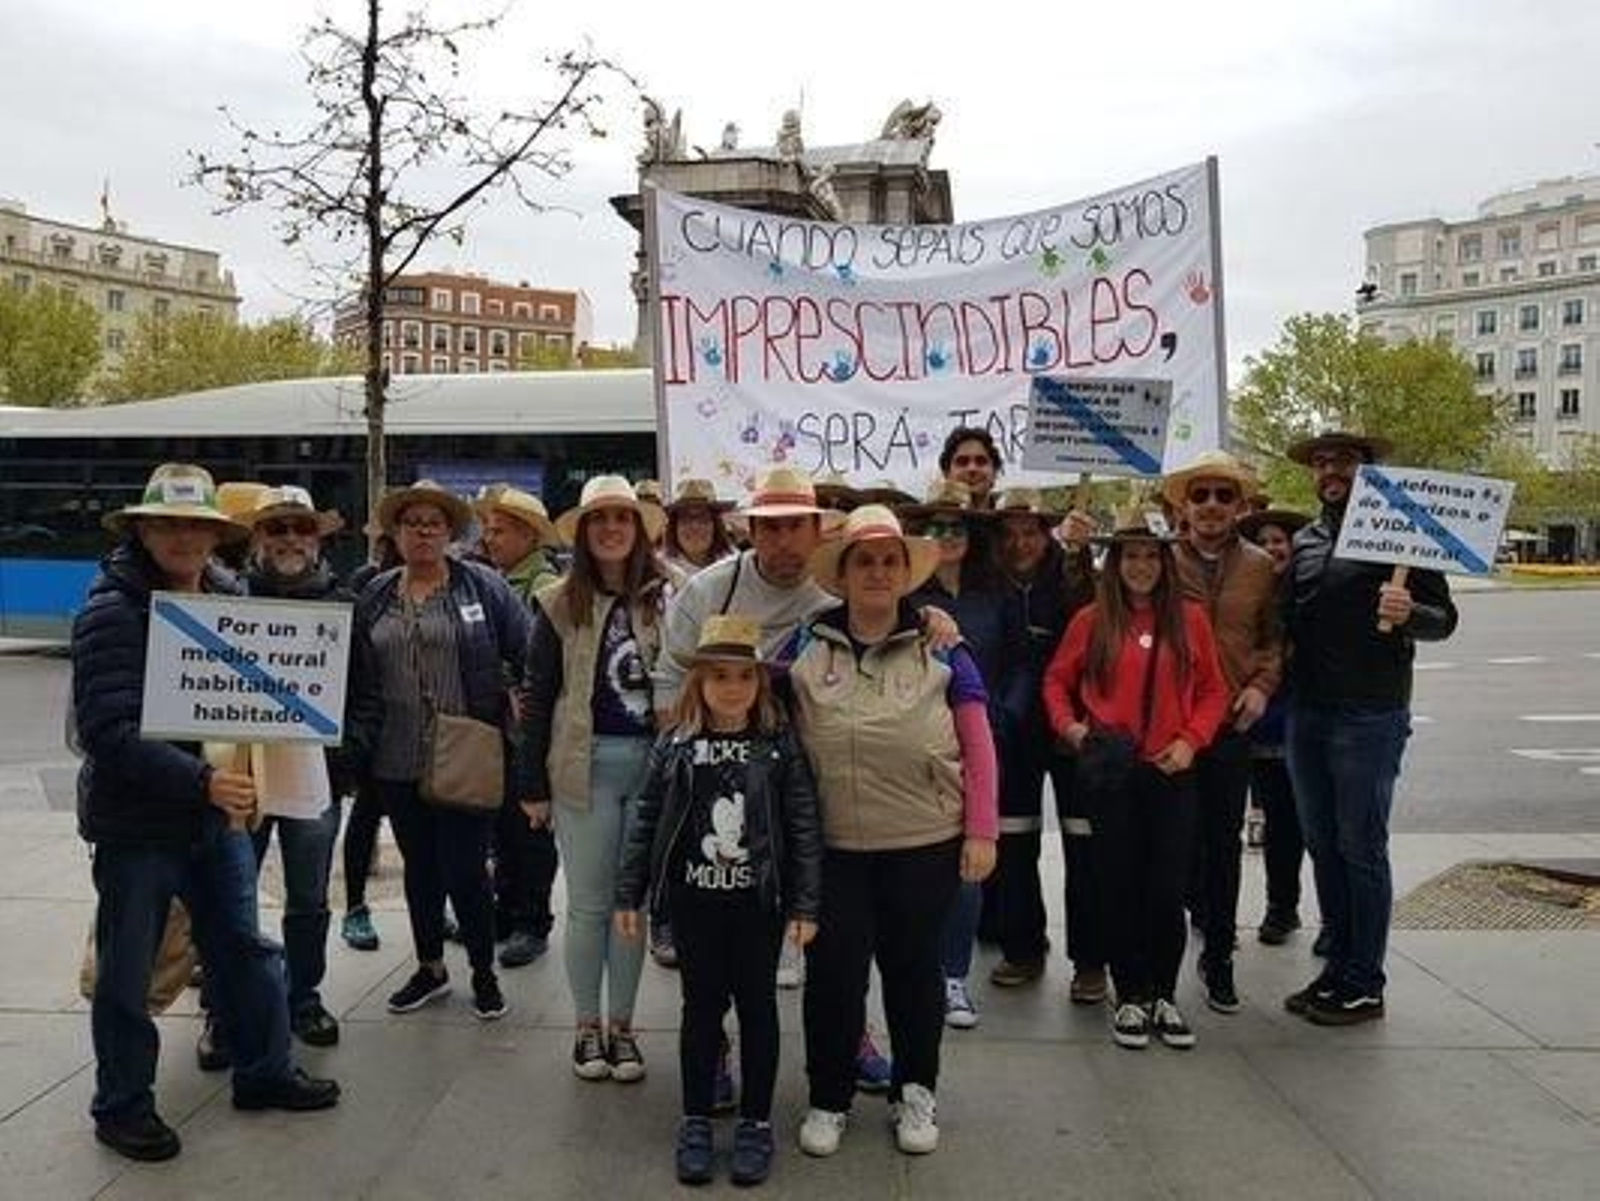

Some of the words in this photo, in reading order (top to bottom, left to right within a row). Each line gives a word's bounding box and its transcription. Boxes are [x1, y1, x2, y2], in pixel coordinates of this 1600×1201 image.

[1071, 184, 1189, 250] SOMOS
[1396, 478, 1475, 499] defensa
[1371, 517, 1417, 534] VIDA
[1346, 537, 1405, 556] medio
[1410, 545, 1461, 562] rural
[217, 616, 260, 637] Por
[268, 622, 297, 637] un
[181, 646, 259, 665] medio
[268, 650, 327, 668] rural
[180, 672, 299, 696] habitable
[308, 682, 323, 696] e
[193, 703, 305, 724] habitado
[686, 861, 752, 890] MOUS
